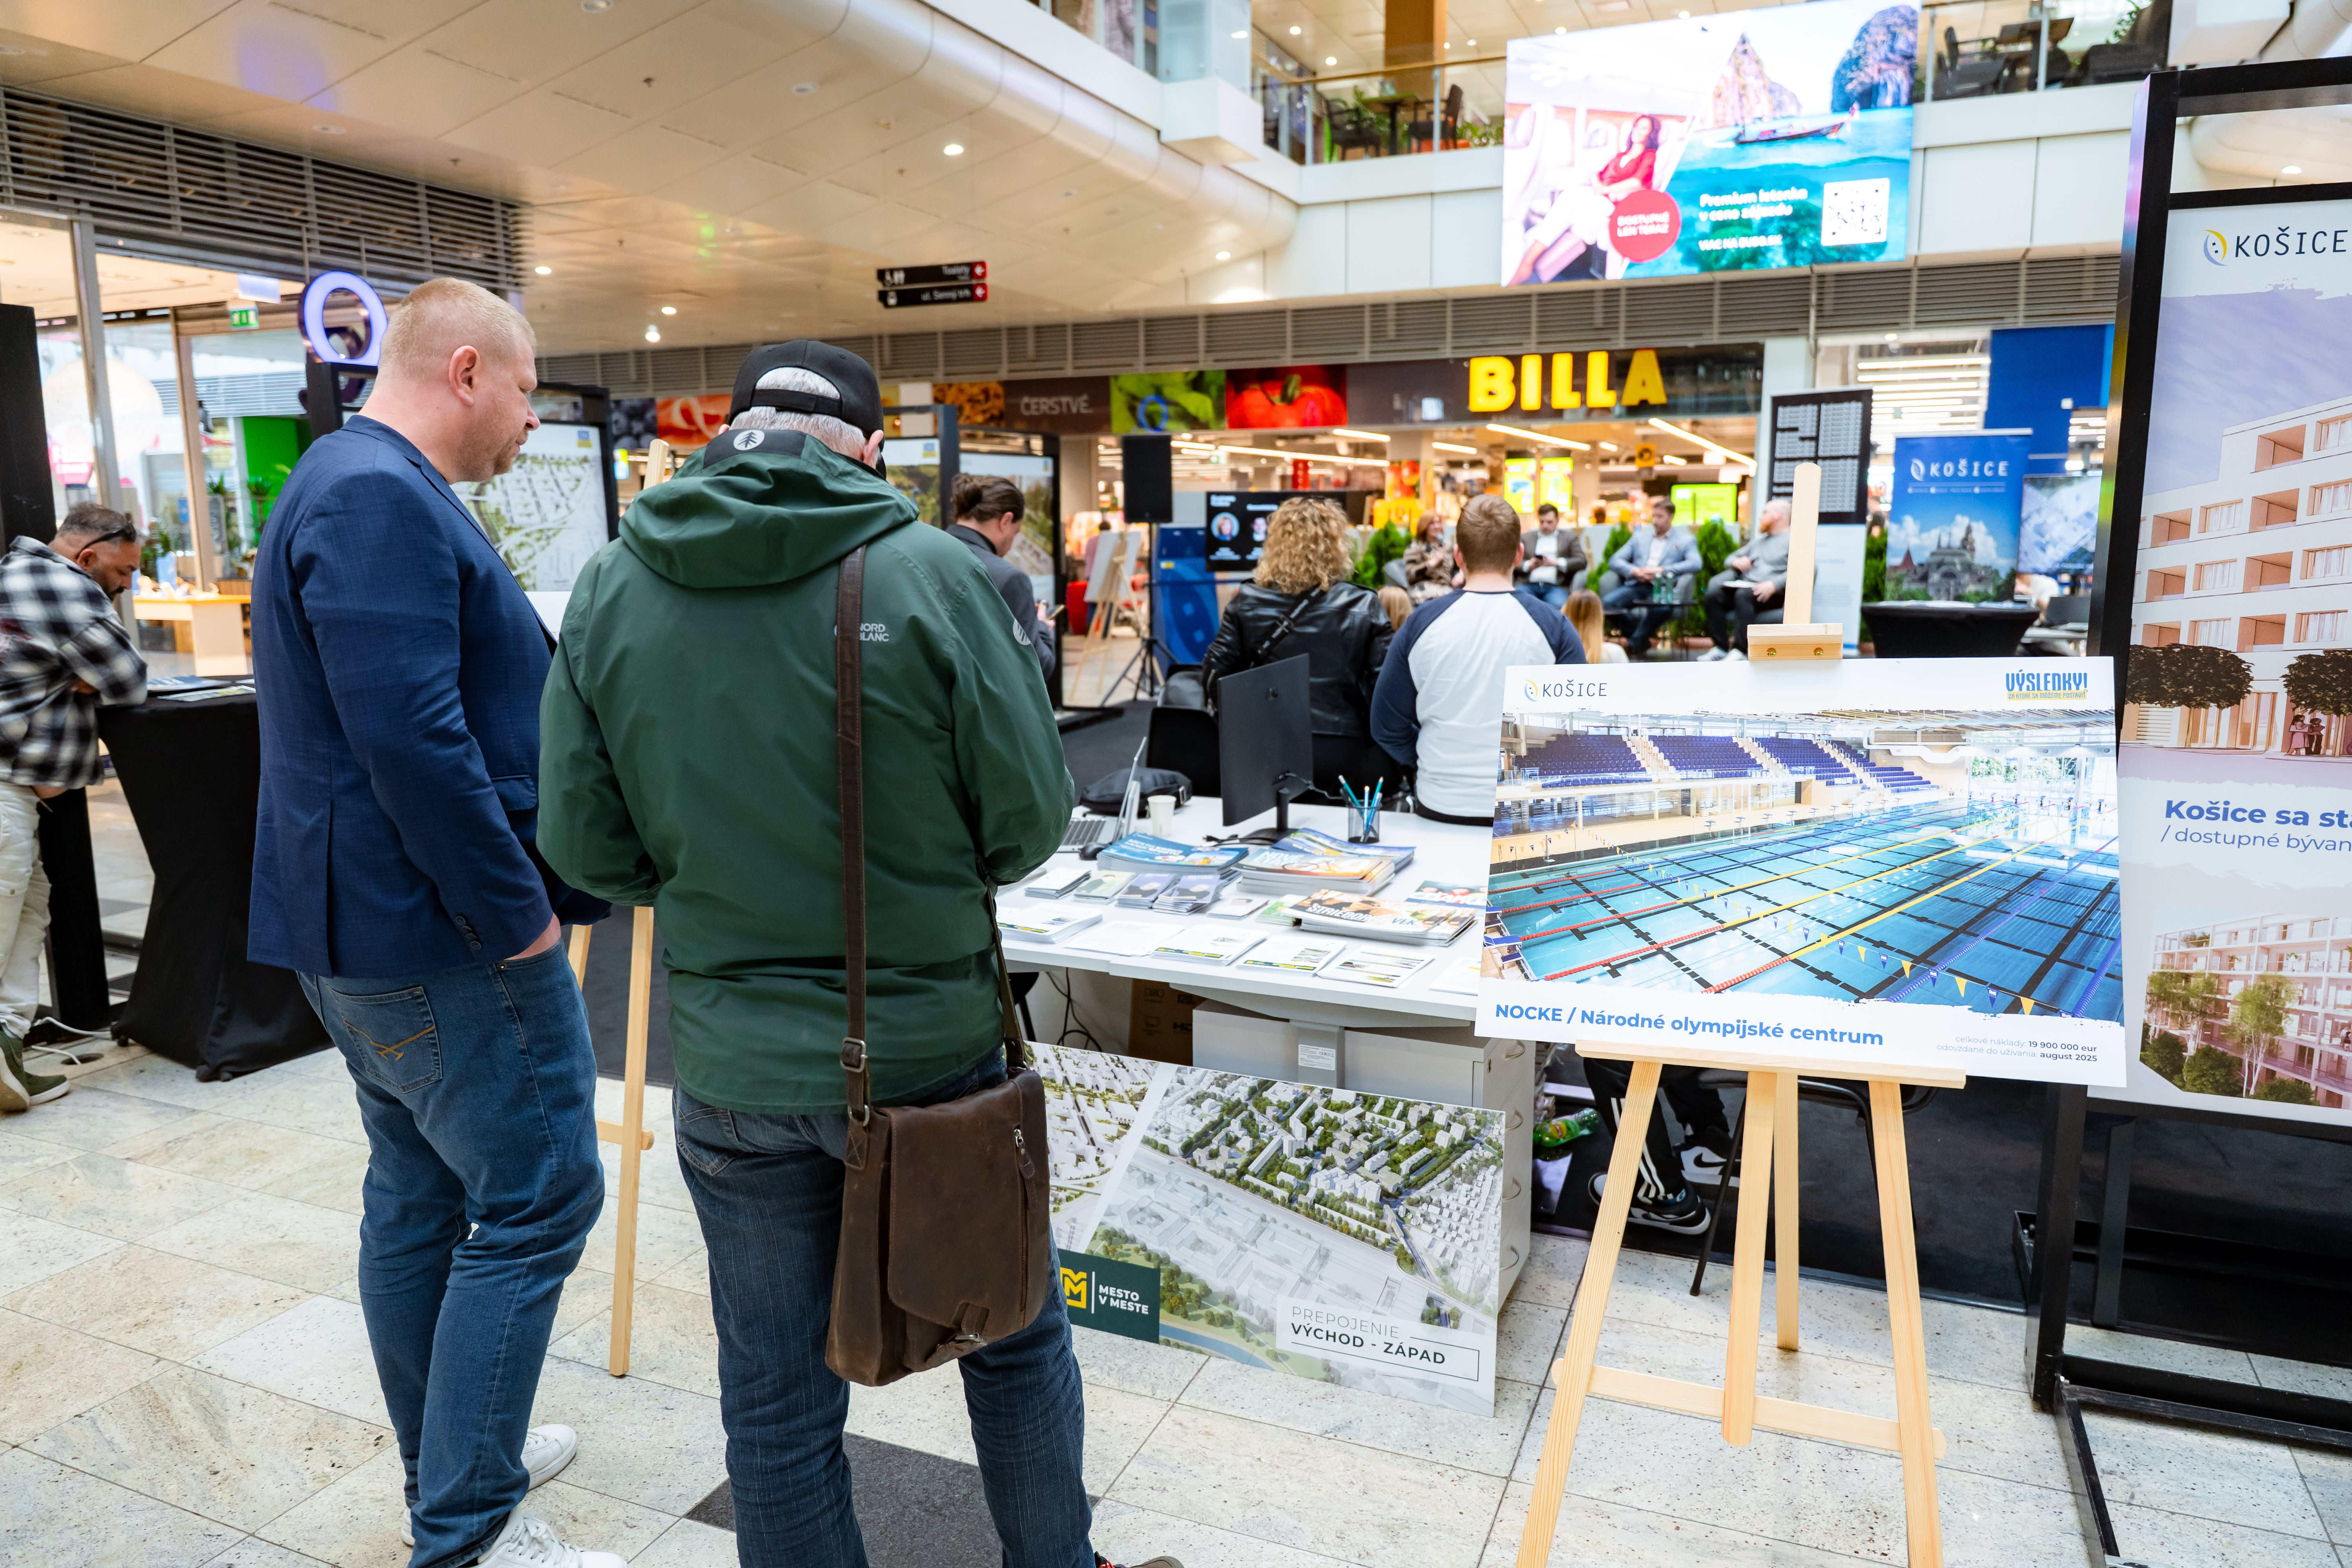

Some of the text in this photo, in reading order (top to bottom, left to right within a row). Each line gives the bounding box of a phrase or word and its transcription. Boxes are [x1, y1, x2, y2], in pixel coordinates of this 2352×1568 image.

[1700, 186, 1808, 207] Premium letenka
[1699, 211, 1709, 222] v
[1709, 209, 1740, 221] cene
[2235, 226, 2348, 258] KOŠICE
[1469, 348, 1667, 412] BILLA
[1930, 458, 2009, 477] KOŠICE
[1543, 679, 1607, 697] KOŠICE
[2006, 669, 2087, 691] VÝSLEDKY!
[2165, 800, 2267, 823] Košice
[2275, 810, 2309, 826] sa
[2175, 828, 2279, 849] dostupné
[1306, 904, 1385, 923] STRIEBORN
[1495, 1004, 1563, 1022] NOCKE
[1581, 1010, 1665, 1029] Národné
[1671, 1017, 1784, 1038] olympijské
[1790, 1026, 1883, 1045] centrum
[1937, 1044, 1984, 1053] odovzdané
[2000, 1049, 2038, 1057] užívania:
[1990, 1039, 2026, 1048] náklady:
[1099, 1285, 1140, 1301] MESTO
[1099, 1295, 1149, 1315] V MESTE
[1292, 1306, 1399, 1339] PREPOJENIE
[1291, 1323, 1364, 1348] VÝCHOD
[1383, 1342, 1445, 1364] ZÁPAD
